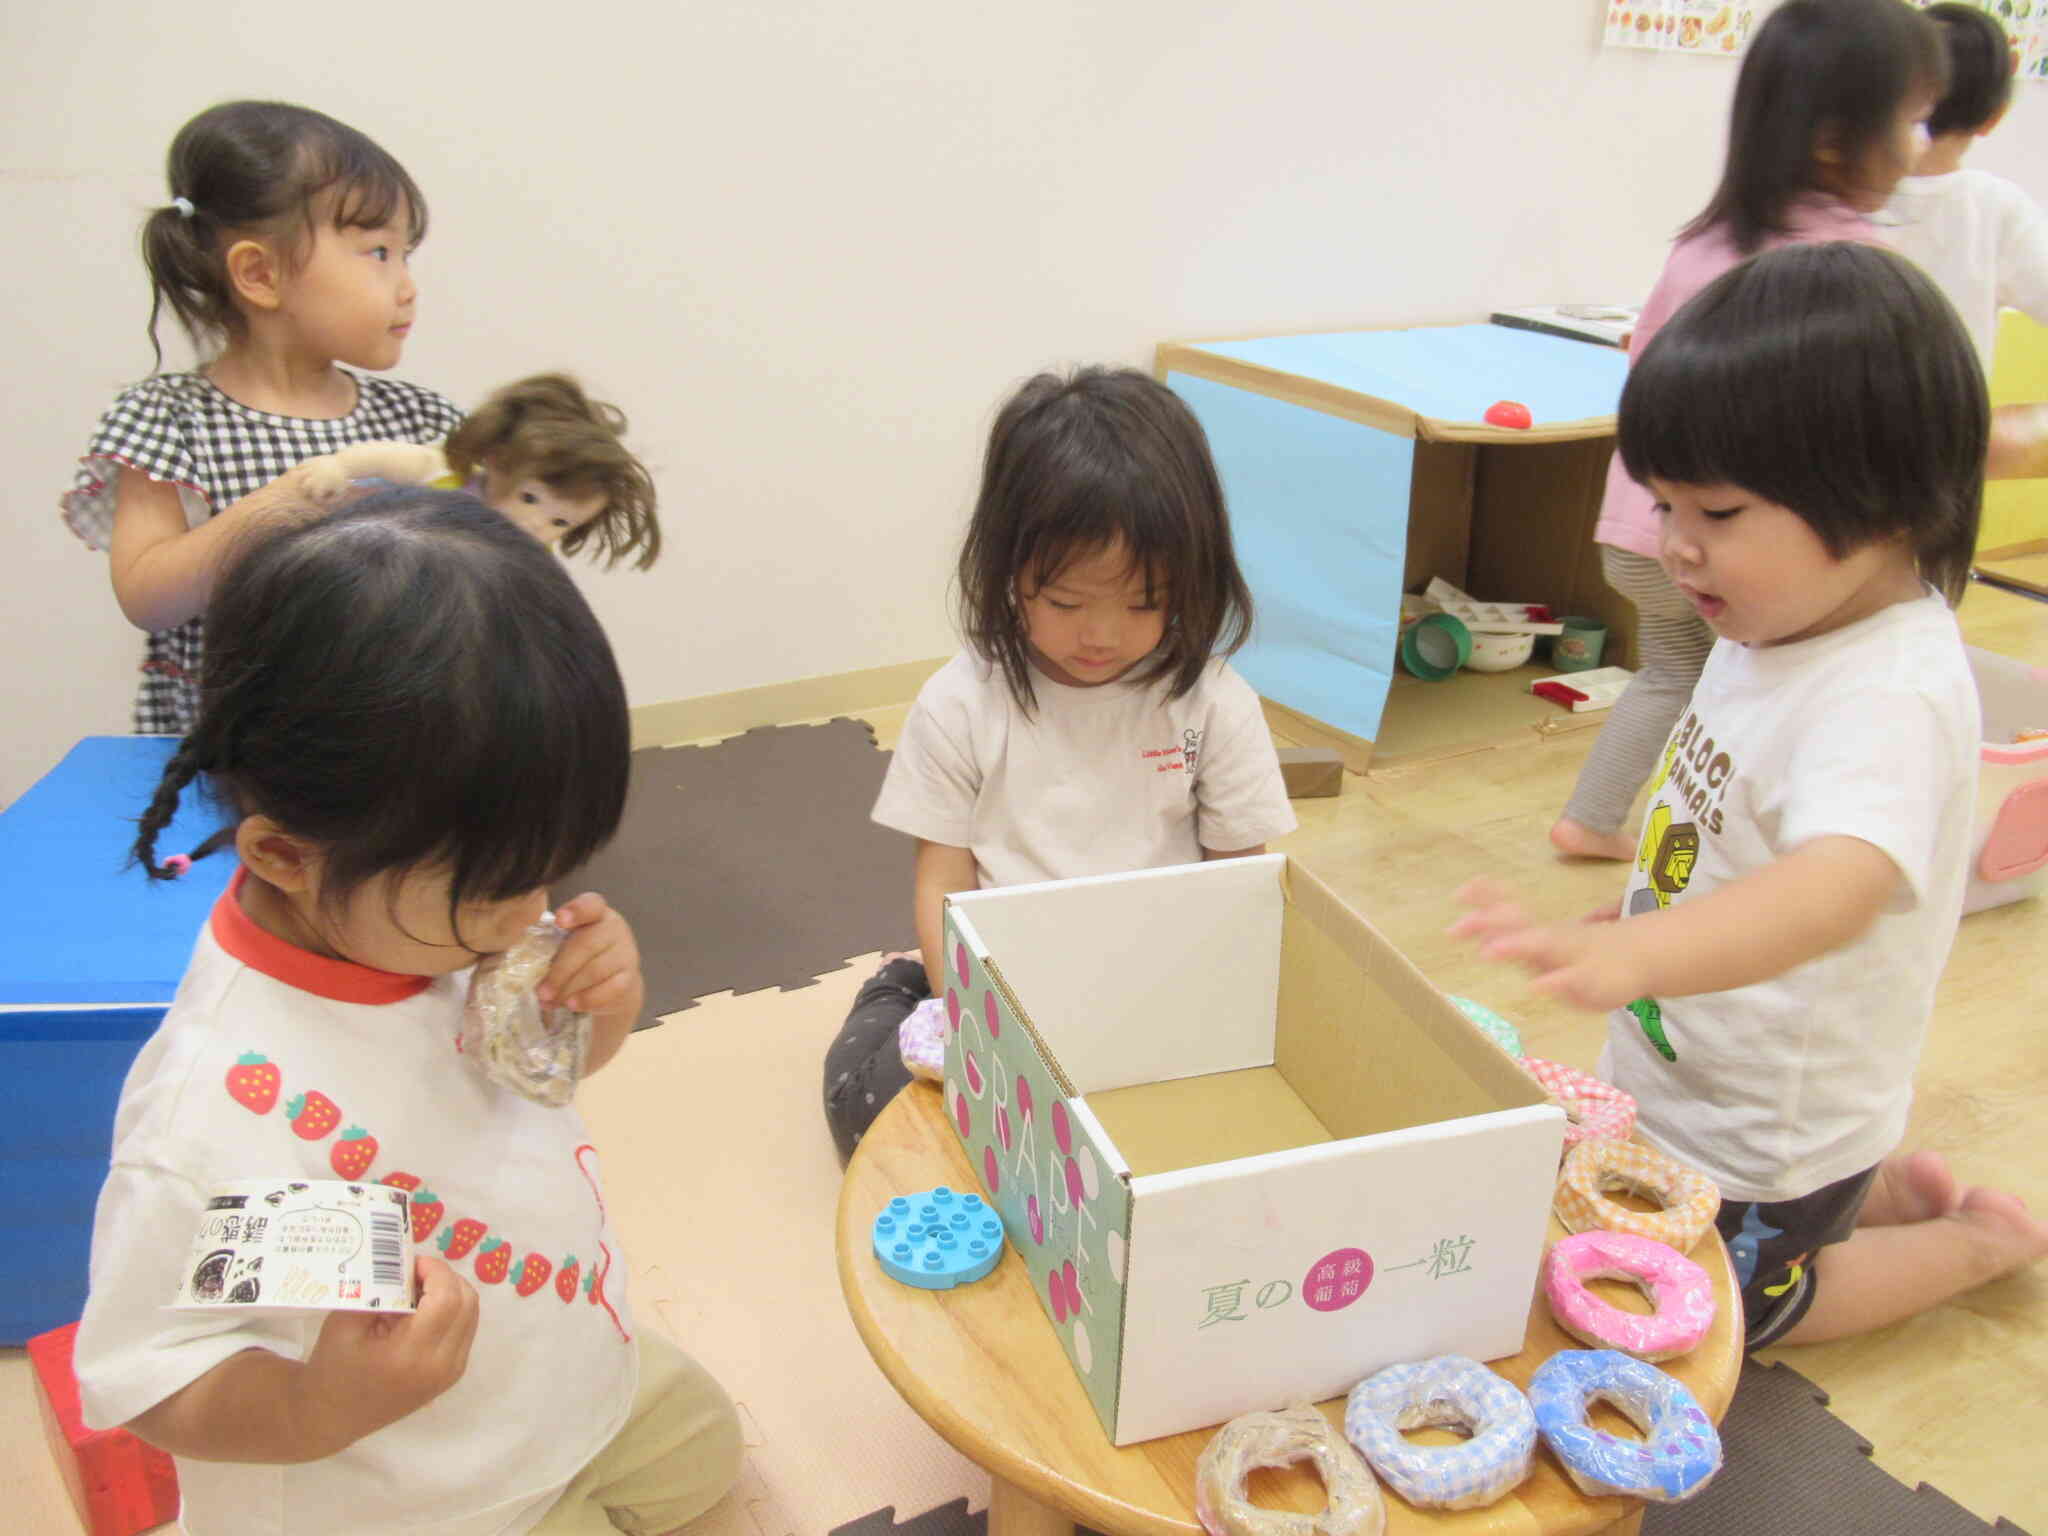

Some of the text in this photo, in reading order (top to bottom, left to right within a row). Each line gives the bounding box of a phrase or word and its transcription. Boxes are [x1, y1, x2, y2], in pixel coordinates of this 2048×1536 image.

[1668, 757, 1723, 834] ANIMALS
[957, 1007, 1098, 1317] GRAPE
[1198, 1234, 1476, 1330] 夏の 一粒
[1317, 1257, 1363, 1282] 高級
